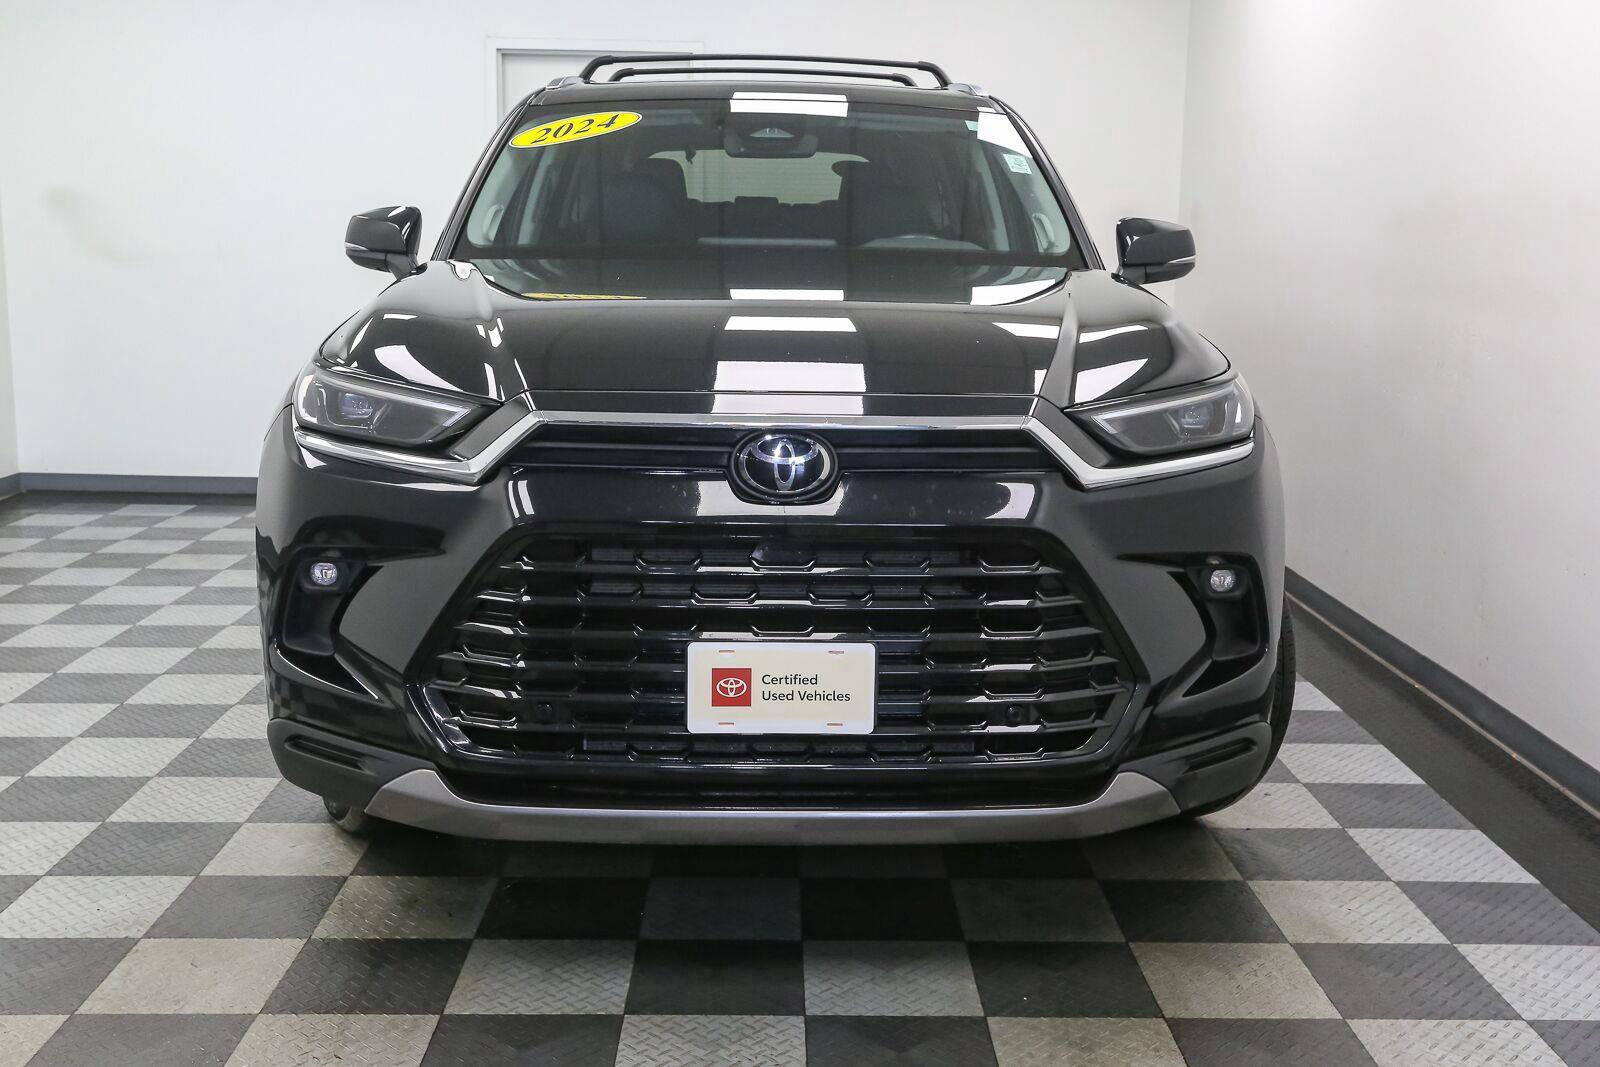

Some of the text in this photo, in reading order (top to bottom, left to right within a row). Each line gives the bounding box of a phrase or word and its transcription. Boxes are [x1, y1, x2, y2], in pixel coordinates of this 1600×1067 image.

[530, 113, 620, 144] 2024
[761, 674, 818, 685] Certified
[761, 690, 851, 702] Used Vehicles
